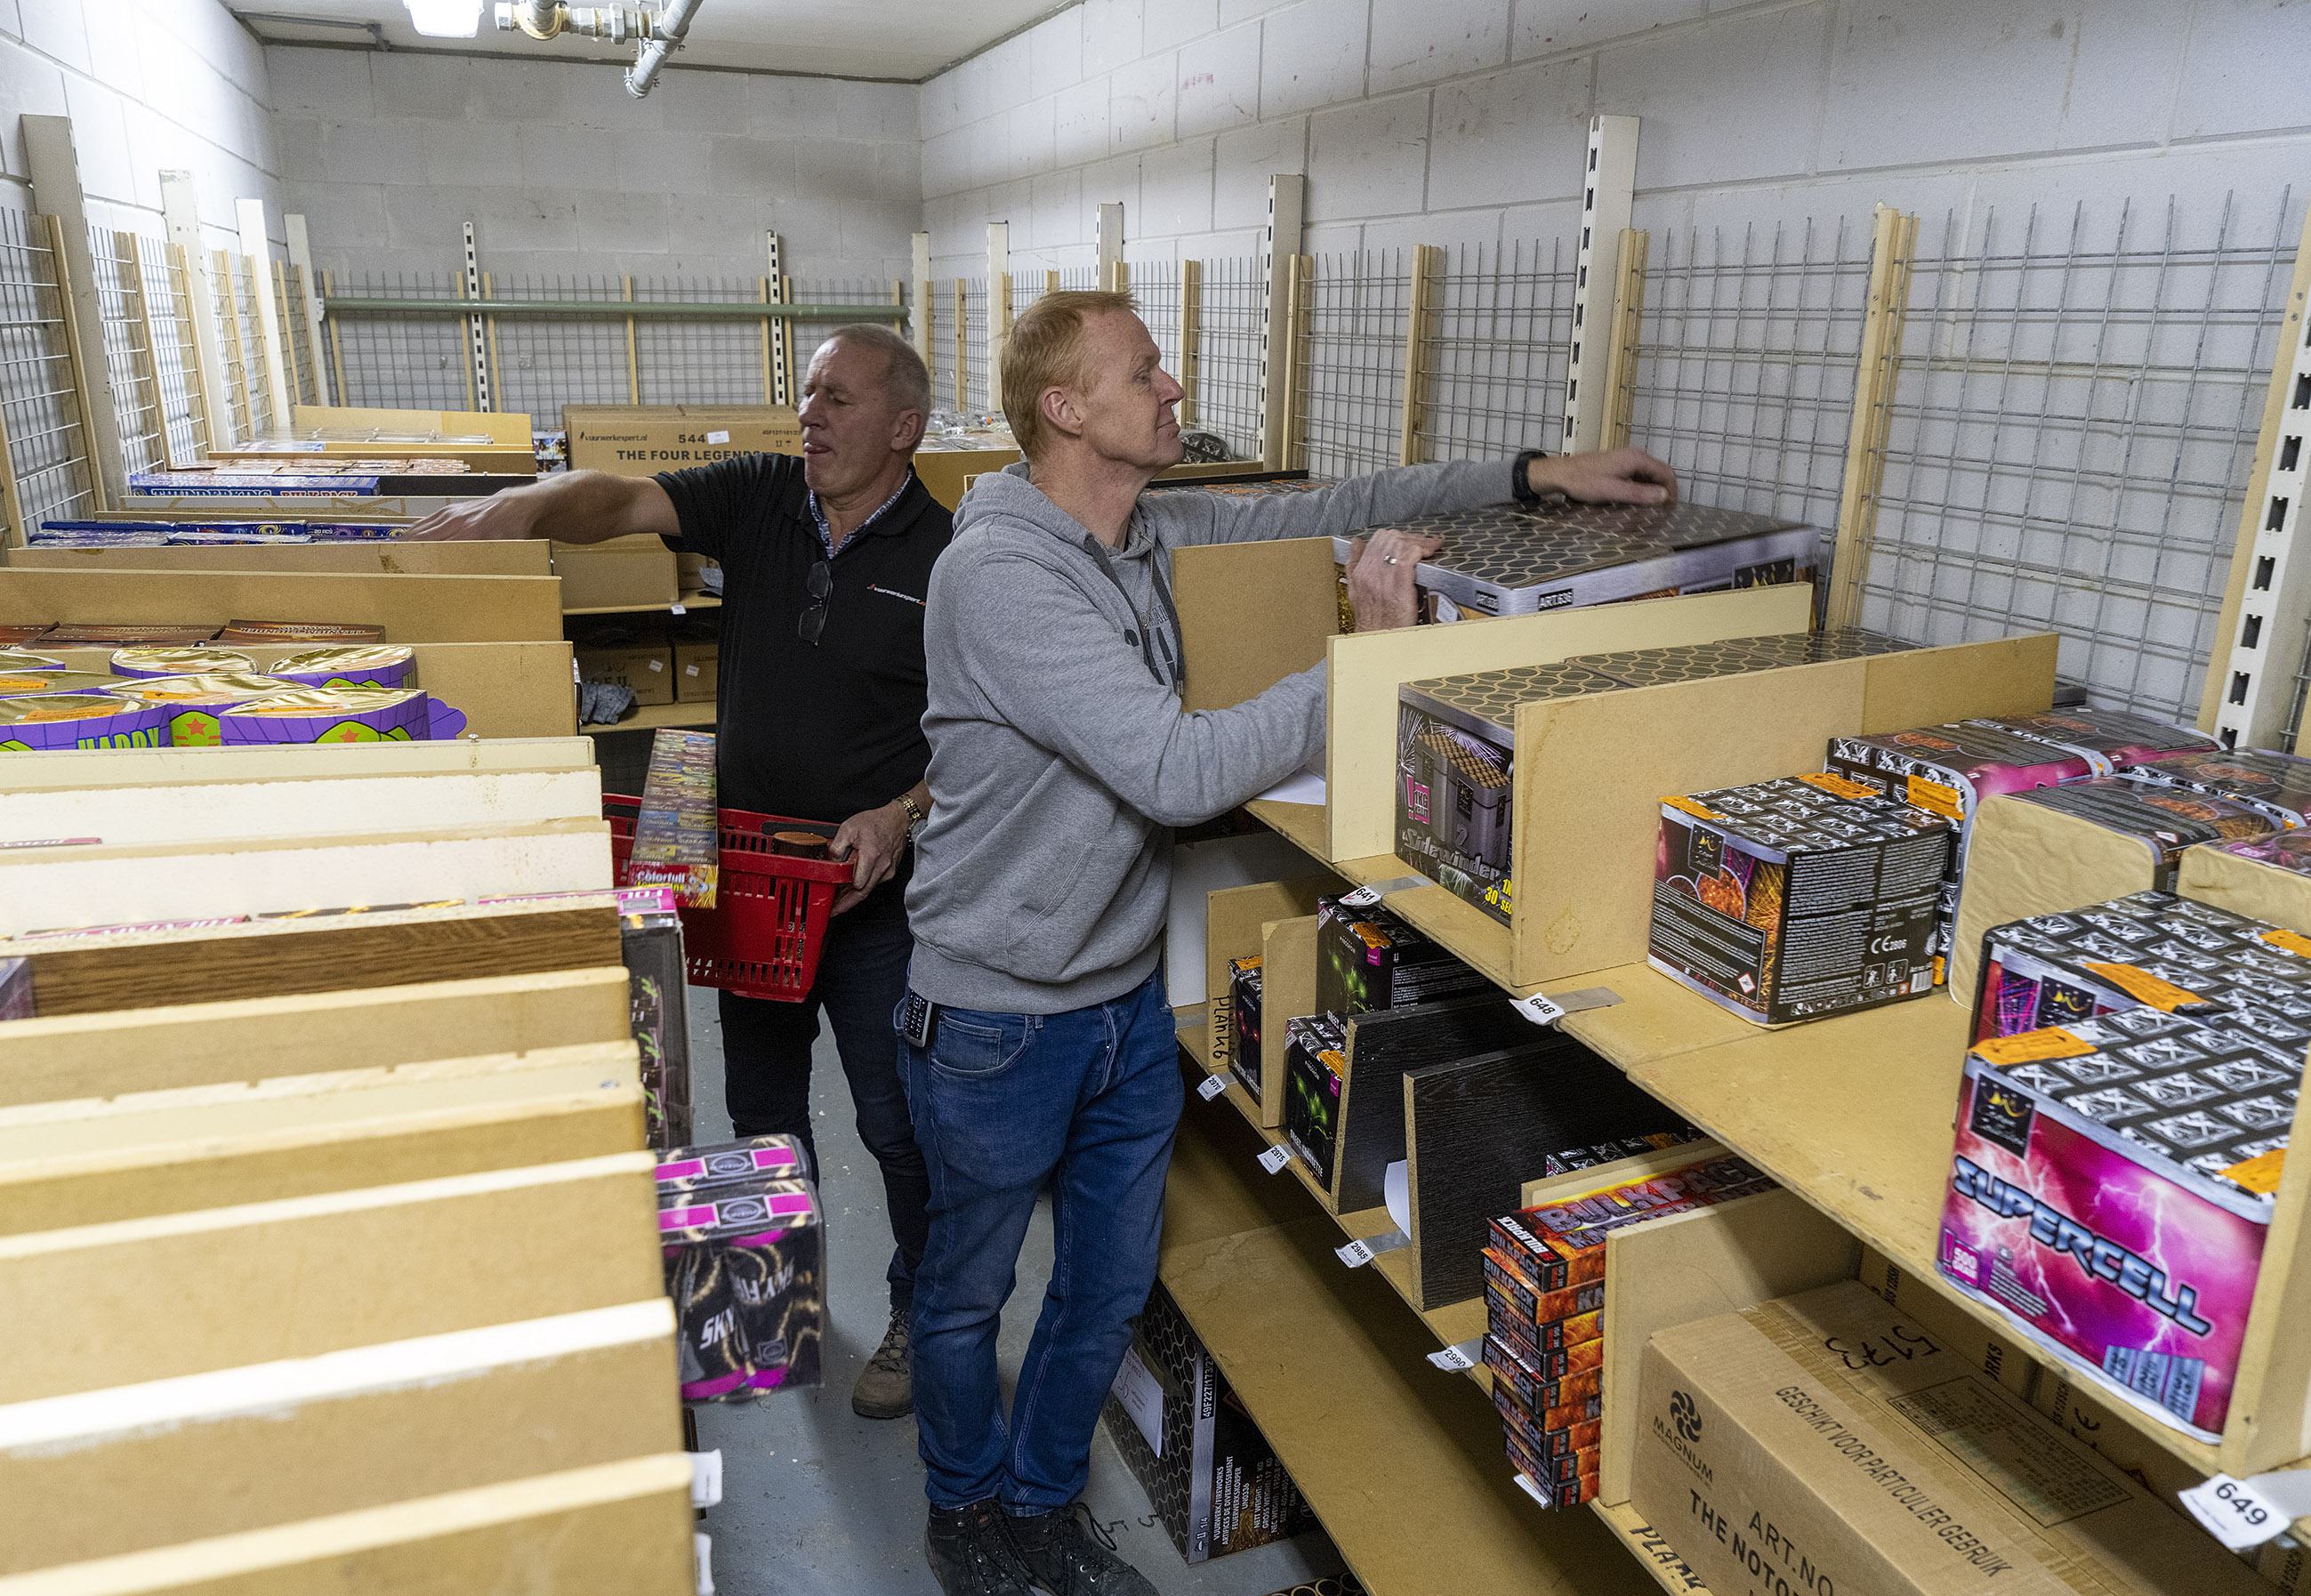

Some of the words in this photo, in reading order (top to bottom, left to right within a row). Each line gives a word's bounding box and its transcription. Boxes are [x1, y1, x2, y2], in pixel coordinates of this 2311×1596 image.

[679, 434, 705, 444] 544
[616, 450, 646, 461] THE
[651, 449, 689, 461] FOUR
[1403, 827, 1501, 882] Sidewinder
[1356, 887, 1376, 902] 641
[1485, 886, 1499, 906] 30
[1530, 997, 1556, 1015] 648
[1271, 1146, 1285, 1163] 2975
[1350, 1242, 1369, 1260] 2985
[1953, 1153, 2212, 1337] SUPERCELL
[1444, 1349, 1466, 1367] 2990
[1653, 1415, 1714, 1483] MAGNUM
[1224, 1455, 1235, 1506] DIVERTISSEMENT
[1775, 1385, 1843, 1434] GESCHIKT
[1827, 1431, 1874, 1463] VOOR
[1860, 1457, 1952, 1530] PARTICULIER
[1937, 1524, 2013, 1577] GEBRUIK
[1221, 1516, 1230, 1545] ARTIFICES
[1689, 1487, 1728, 1544] THE
[1732, 1532, 1799, 1596] NOTO
[1749, 1511, 1834, 1596] ART.NO
